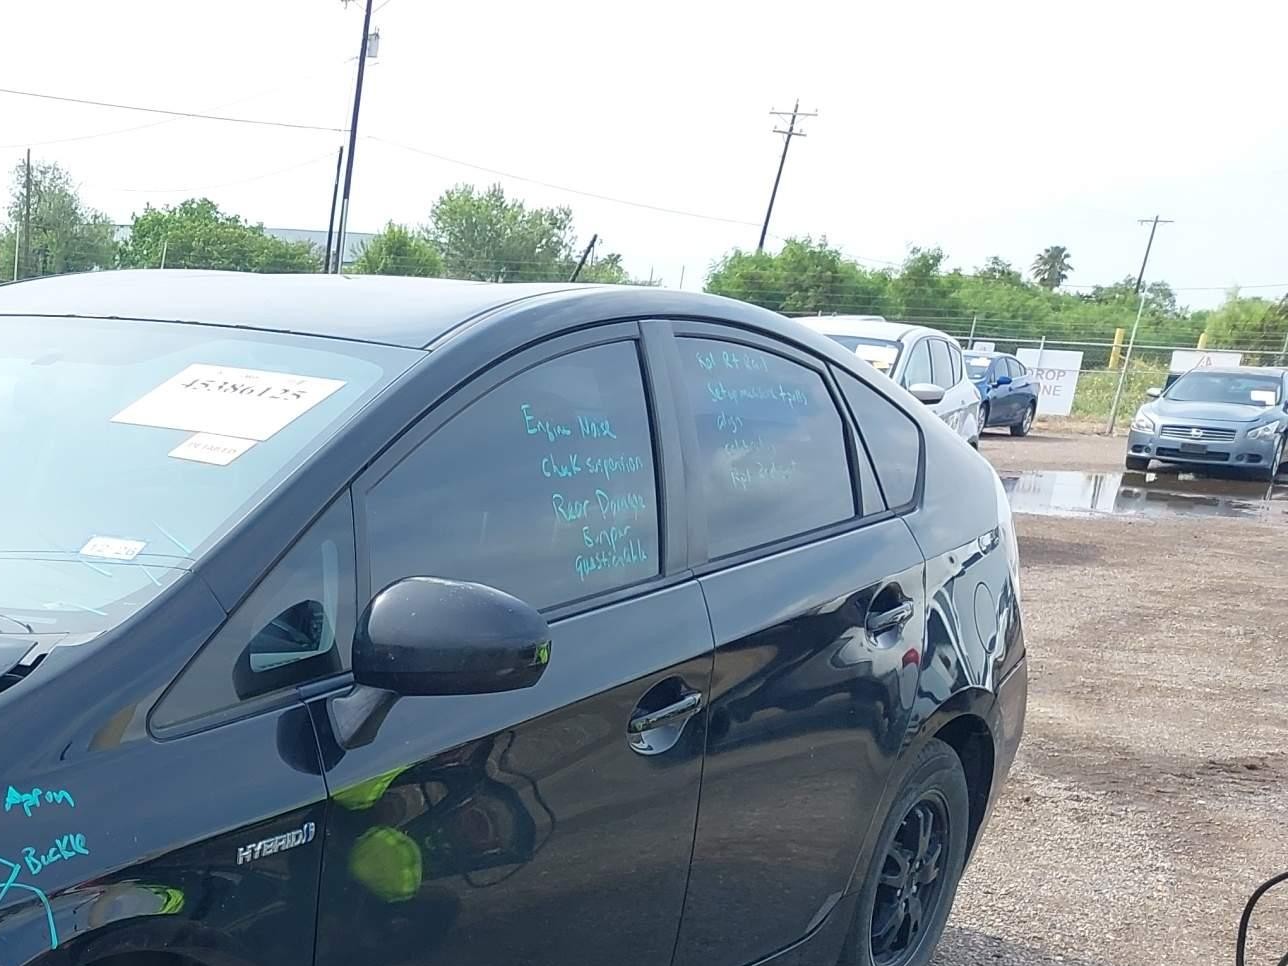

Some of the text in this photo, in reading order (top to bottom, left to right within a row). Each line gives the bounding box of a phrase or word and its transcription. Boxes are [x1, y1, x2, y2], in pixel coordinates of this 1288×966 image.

[1042, 384, 1064, 397] NE
[521, 404, 617, 442] Engine Noise
[552, 489, 646, 521] Rear Damage
[236, 829, 304, 865] HYBRID
